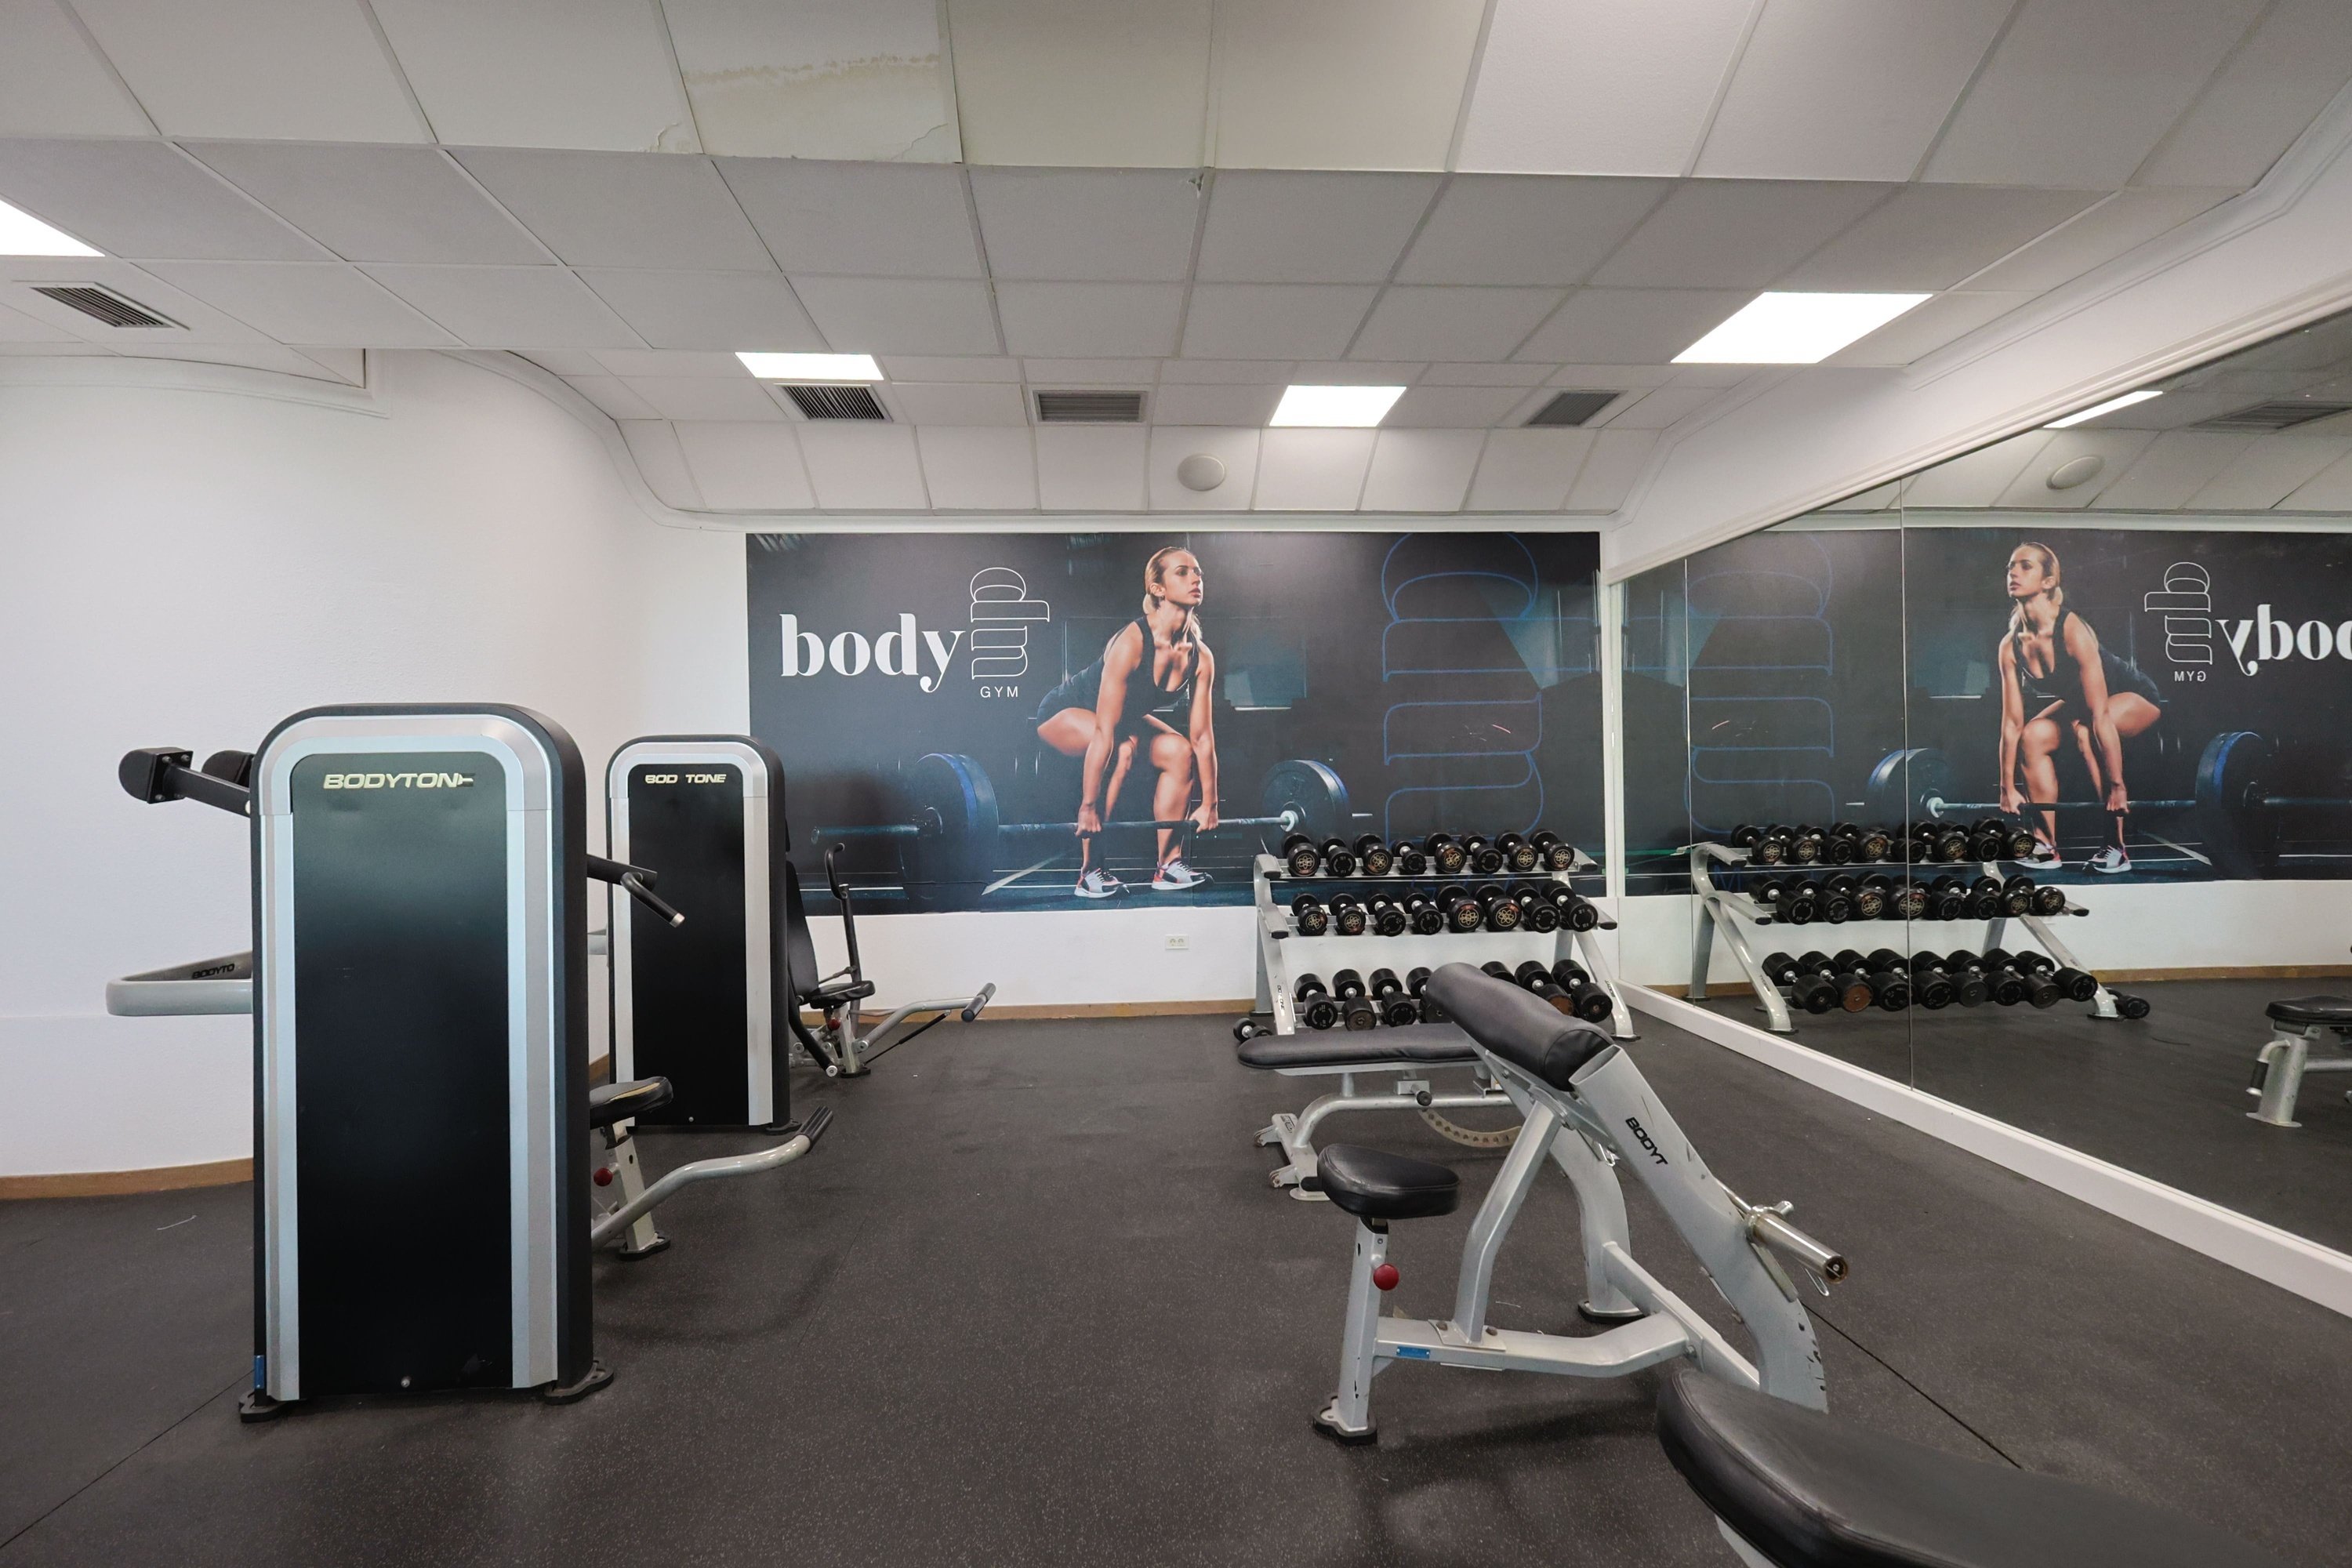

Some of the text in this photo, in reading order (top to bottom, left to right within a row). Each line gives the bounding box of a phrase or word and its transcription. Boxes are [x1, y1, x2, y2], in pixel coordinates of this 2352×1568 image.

[779, 612, 966, 693] body
[980, 685, 1019, 698] GYM
[1625, 1116, 1668, 1164] BODYT
